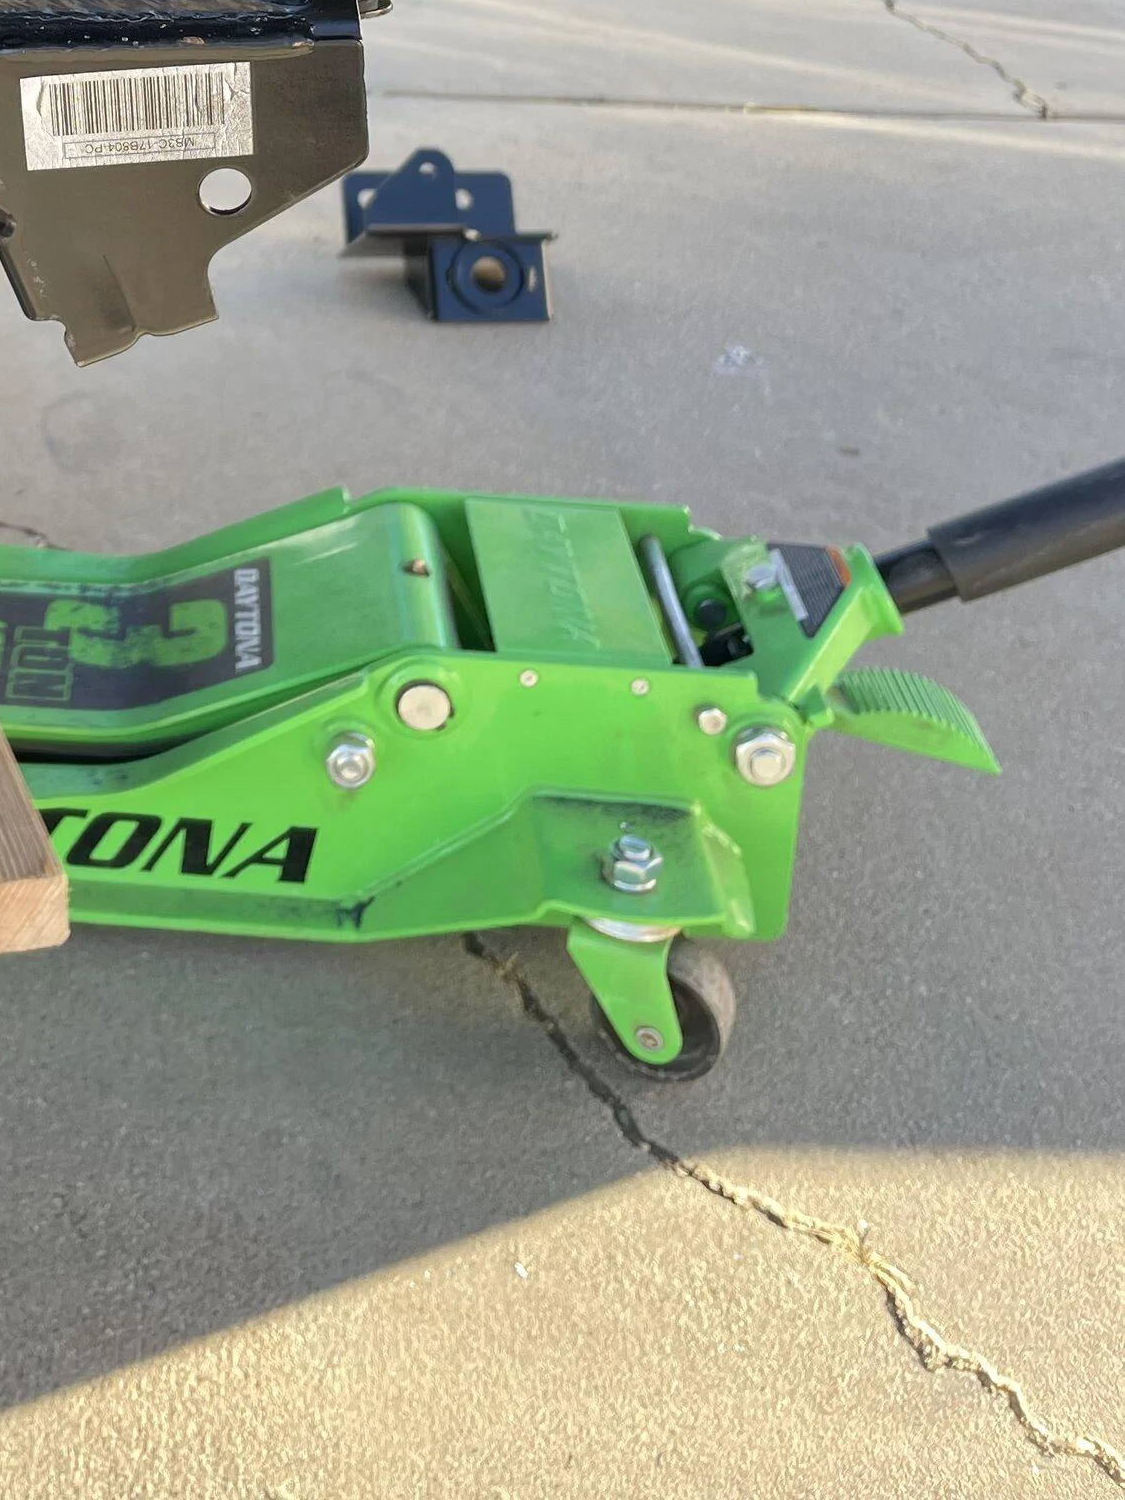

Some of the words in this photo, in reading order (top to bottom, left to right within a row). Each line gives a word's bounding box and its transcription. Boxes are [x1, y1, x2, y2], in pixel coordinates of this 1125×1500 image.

[43, 599, 229, 669] 3
[233, 567, 263, 673] DAYTONA
[5, 625, 74, 701] TON
